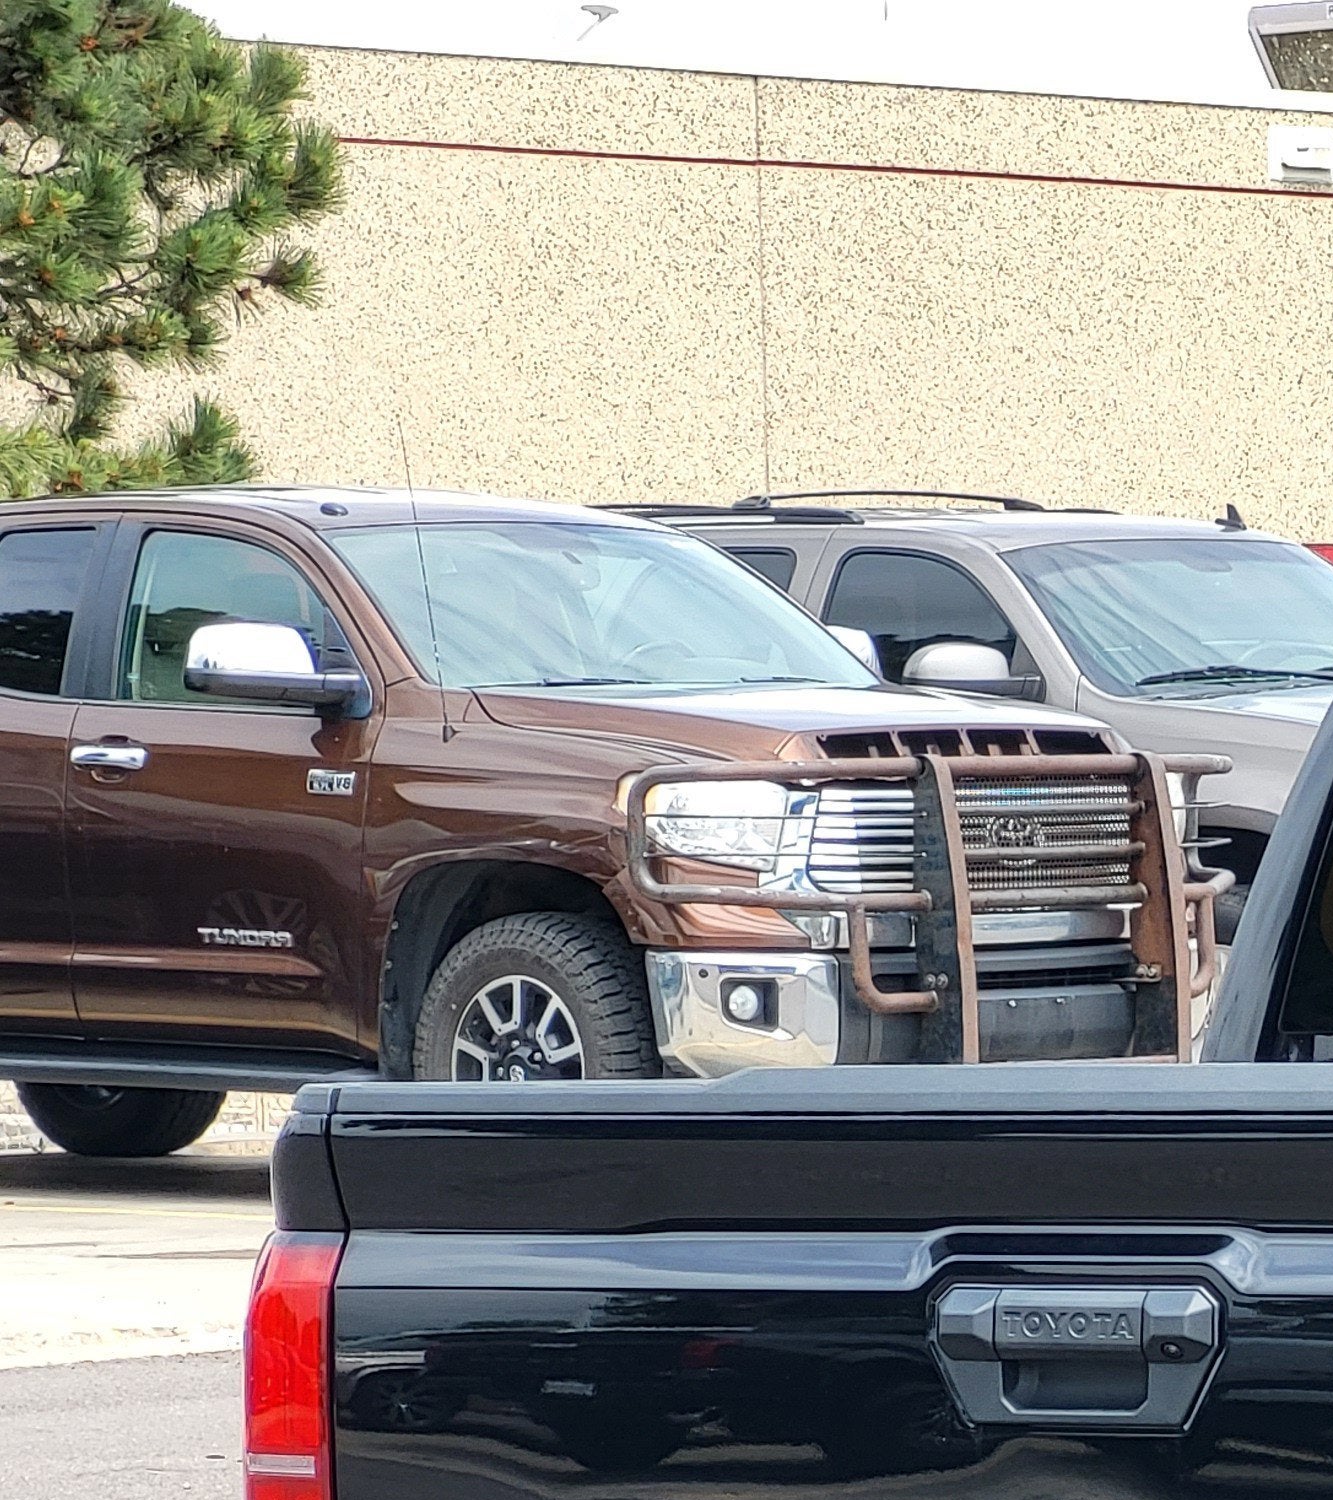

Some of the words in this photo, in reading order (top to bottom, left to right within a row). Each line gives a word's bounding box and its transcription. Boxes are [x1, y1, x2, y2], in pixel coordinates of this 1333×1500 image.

[336, 776, 351, 790] V8
[197, 927, 293, 948] TUNDRA
[1001, 1310, 1134, 1340] TOYOTA
